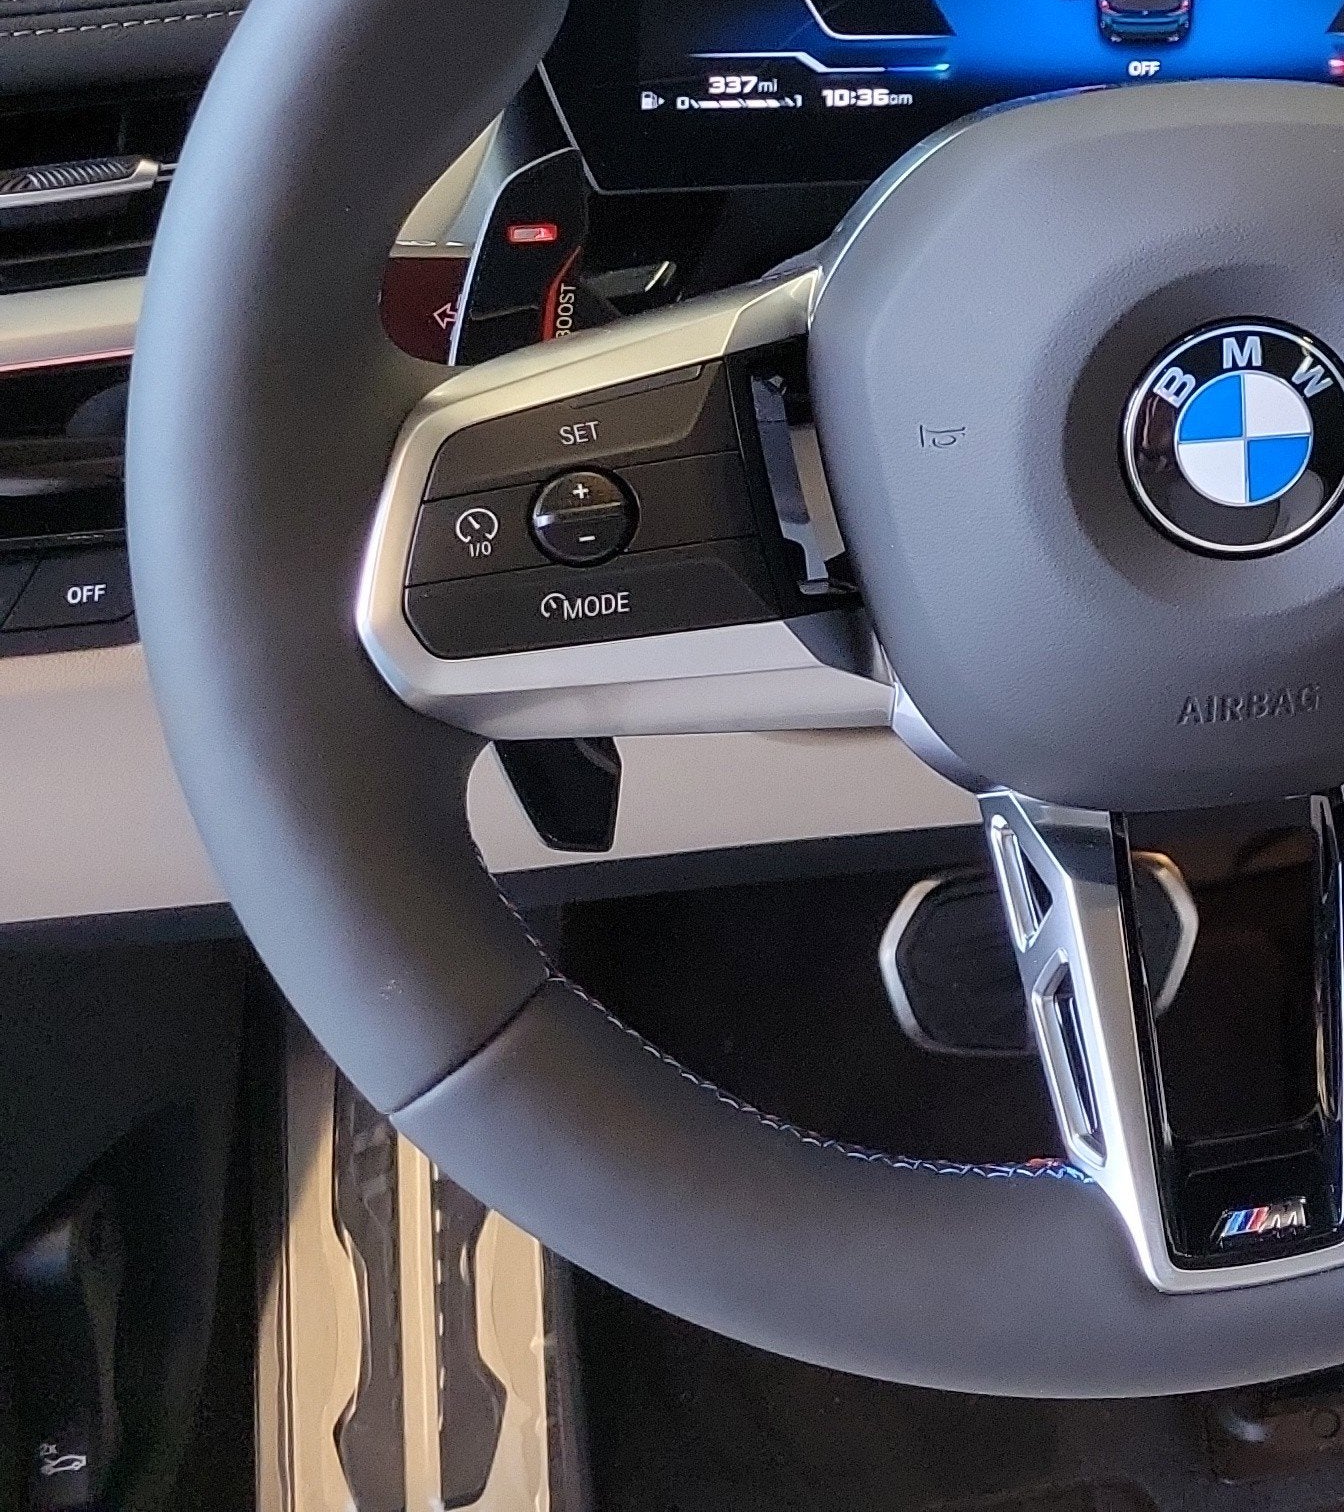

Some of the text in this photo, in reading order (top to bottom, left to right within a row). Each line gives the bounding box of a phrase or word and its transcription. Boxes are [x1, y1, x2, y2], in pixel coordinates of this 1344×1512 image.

[1127, 60, 1161, 77] OFF
[1153, 335, 1334, 409] BMW
[559, 421, 599, 446] SET
[66, 584, 107, 604] OFF
[562, 591, 631, 620] MODE
[1176, 683, 1321, 726] AIRBAG
